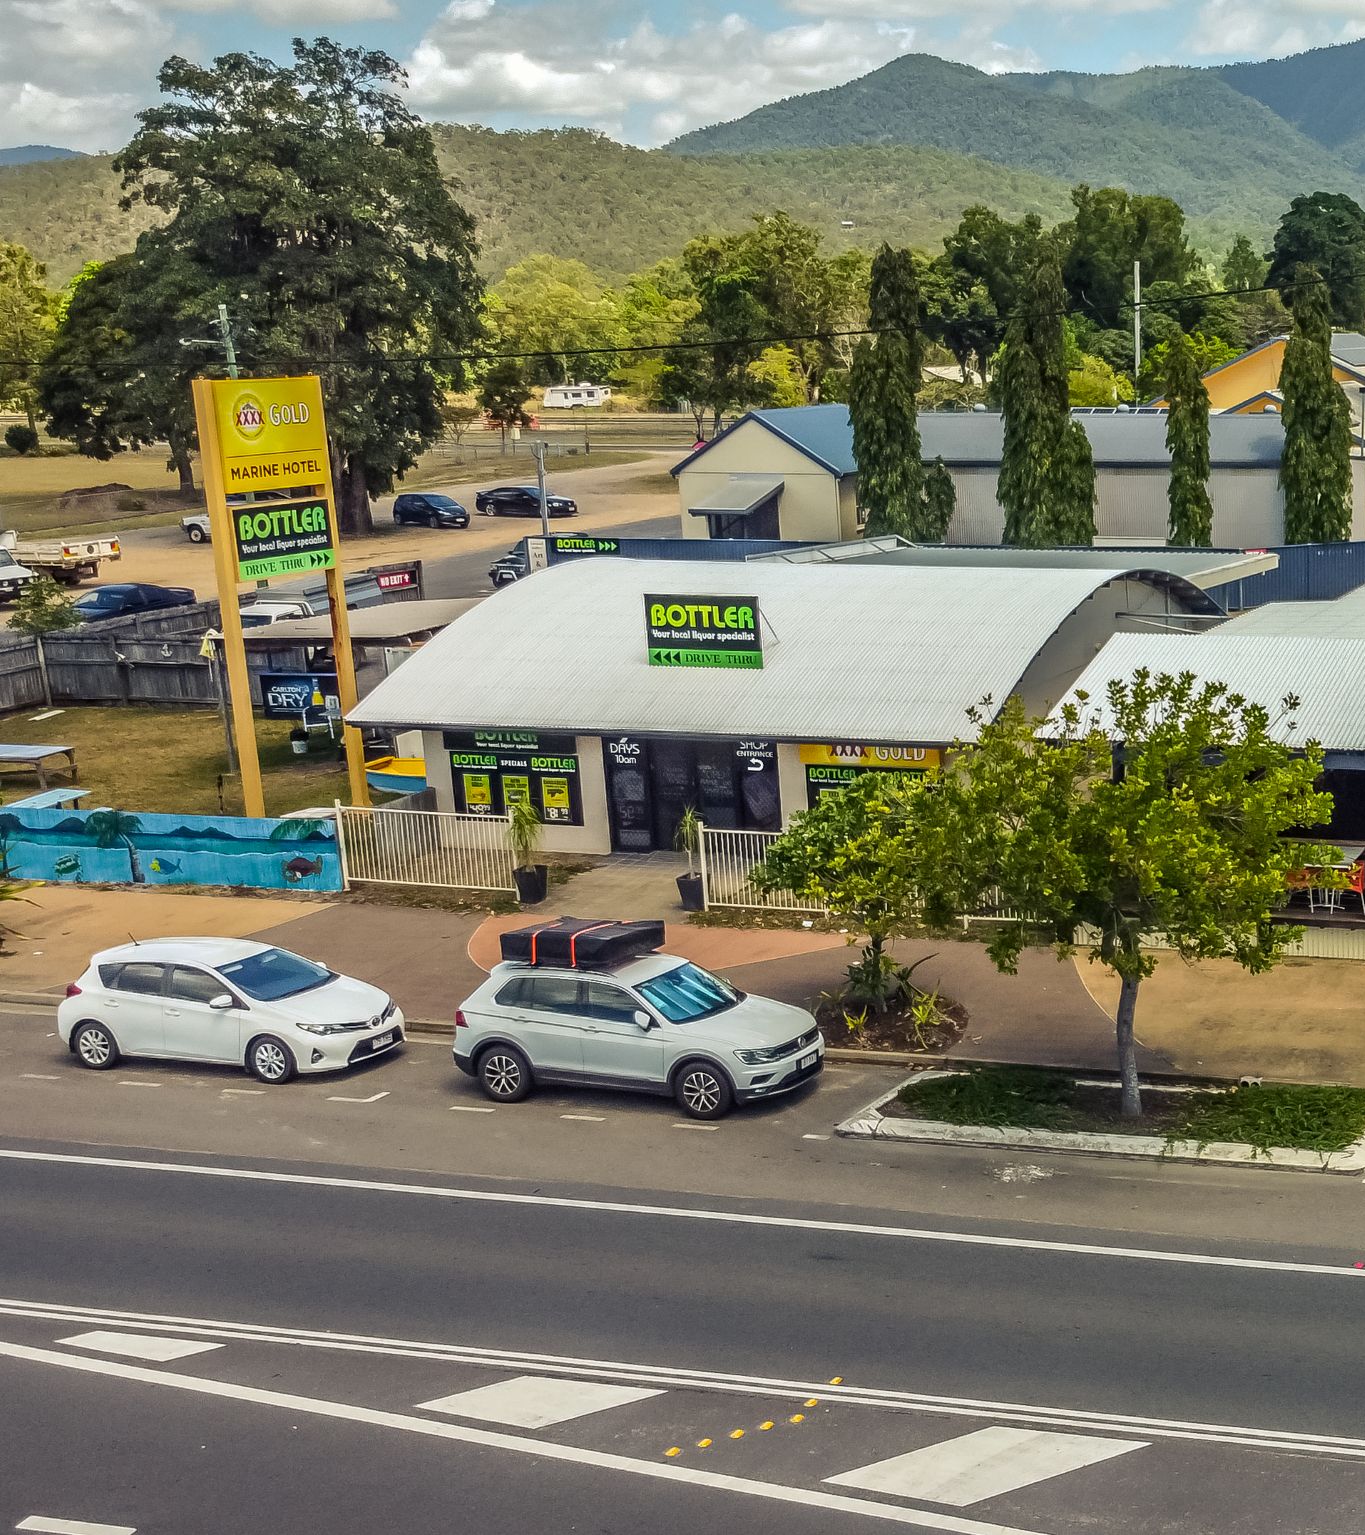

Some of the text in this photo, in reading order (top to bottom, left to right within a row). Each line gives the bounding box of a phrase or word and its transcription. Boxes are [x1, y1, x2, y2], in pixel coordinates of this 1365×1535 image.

[236, 402, 310, 426] XXXX GOLD
[231, 460, 321, 480] MARINE HOTEL
[239, 506, 326, 540] BOTTLER
[242, 534, 328, 554] Your local liquor specialist
[557, 539, 595, 549] BOTTLER
[245, 562, 277, 576] DRIVE
[380, 574, 404, 587] NO EXIT
[651, 604, 754, 629] BOTTLER
[652, 629, 755, 642] Your local liquor specialist
[685, 654, 757, 665] DRIVE THRU
[267, 693, 308, 707] DRY
[609, 742, 640, 755] DAYS
[736, 750, 773, 758] ENTRANCE
[875, 746, 926, 761] GOLD
[453, 755, 497, 765] BOTTLER
[531, 758, 575, 769] BOTTLER
[615, 754, 637, 764] 10am
[809, 767, 856, 779] BOTTLER
